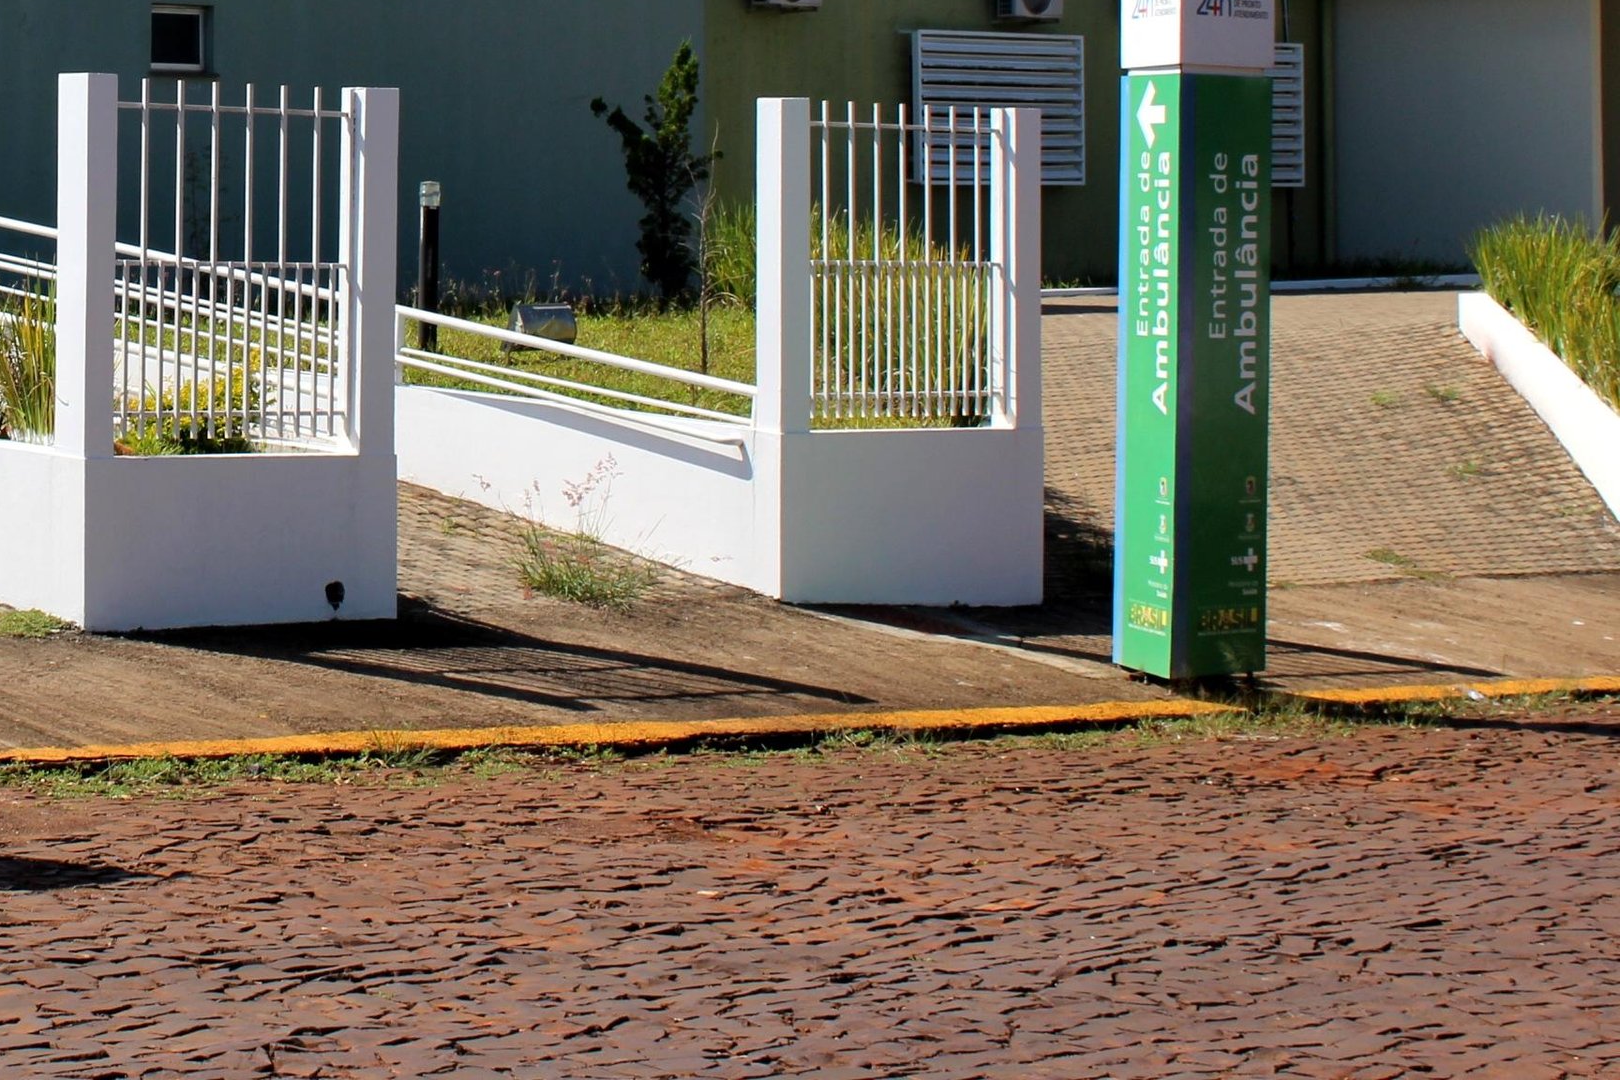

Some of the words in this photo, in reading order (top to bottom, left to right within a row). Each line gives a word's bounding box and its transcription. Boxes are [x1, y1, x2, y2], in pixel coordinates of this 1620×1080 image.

[1137, 151, 1151, 193] de
[1208, 152, 1228, 194] de
[1136, 205, 1150, 337] Entrada
[1151, 151, 1171, 416] Ambulância
[1208, 206, 1228, 339] Entrada
[1234, 154, 1259, 415] Ambulância
